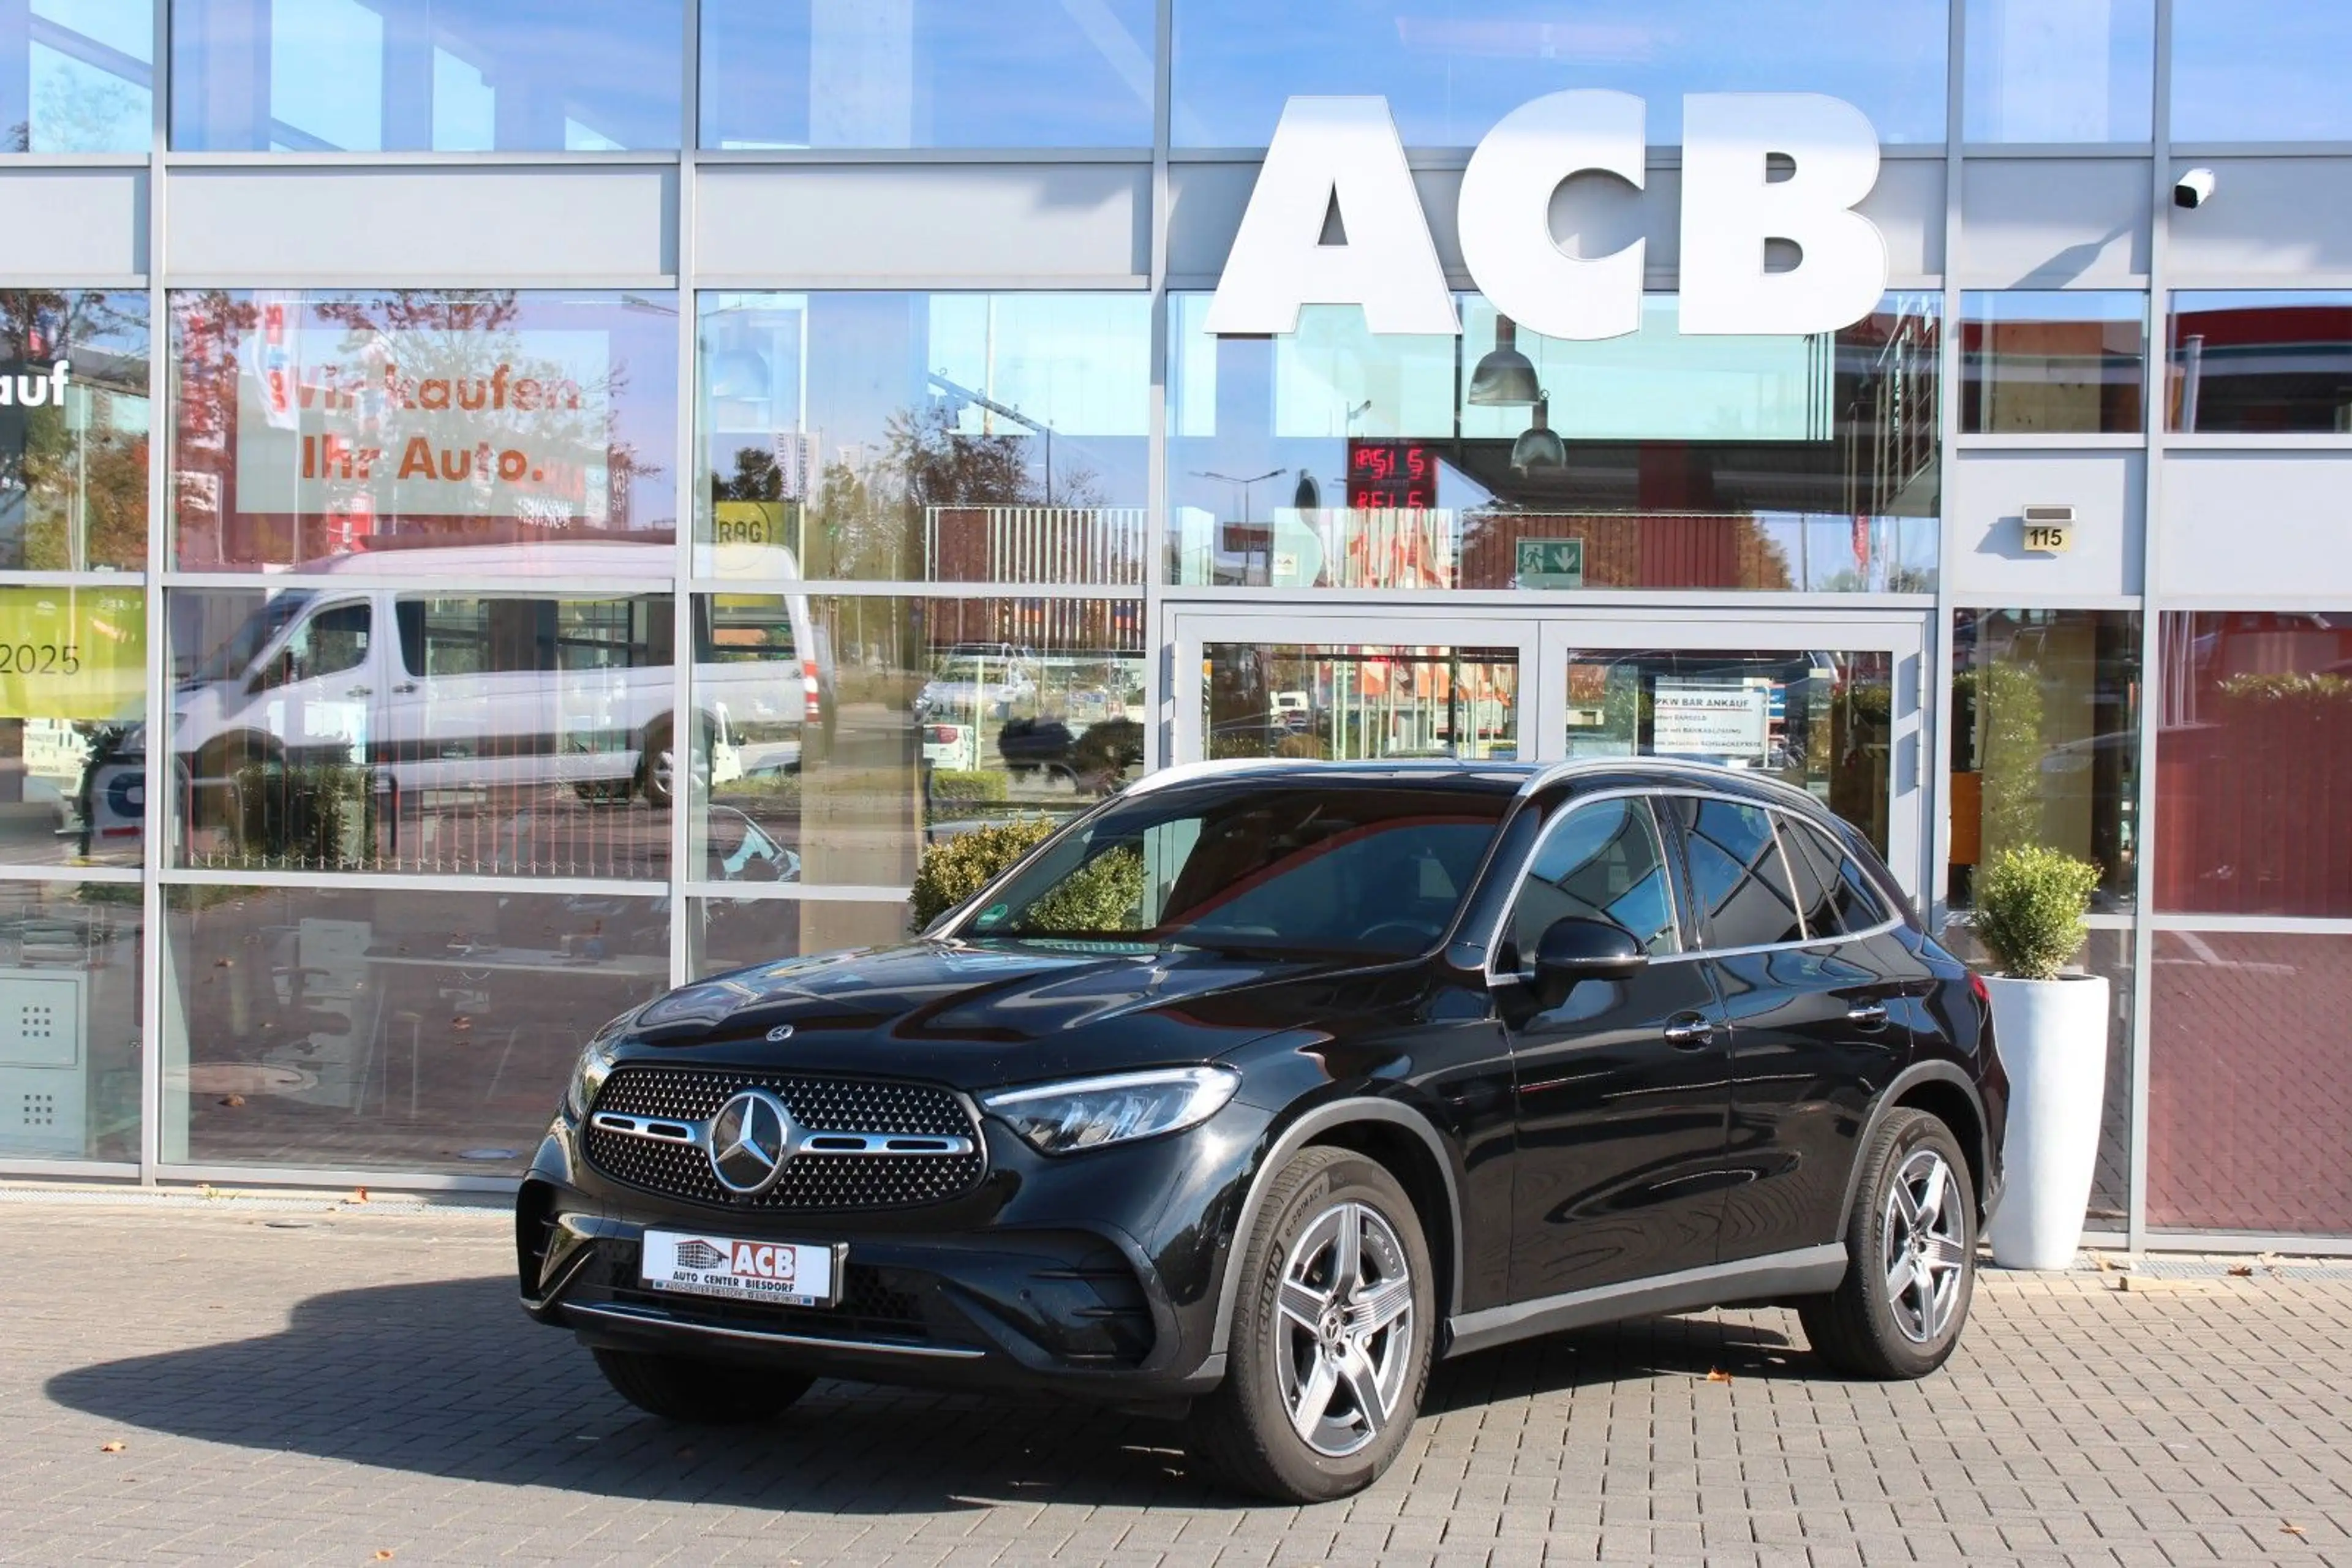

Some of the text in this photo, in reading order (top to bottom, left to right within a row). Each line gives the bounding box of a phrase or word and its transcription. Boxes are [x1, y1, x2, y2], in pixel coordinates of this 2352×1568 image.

[1204, 88, 1889, 342] ACB
[385, 364, 579, 410] kaufen
[303, 434, 544, 481] Ihr Auto.
[2030, 529, 2062, 546] 115
[0, 644, 80, 675] 2025
[673, 1270, 794, 1292] AUTO CENTER BIESDORF
[733, 1244, 794, 1278] ACB
[1257, 1241, 1284, 1348] ICHELIN
